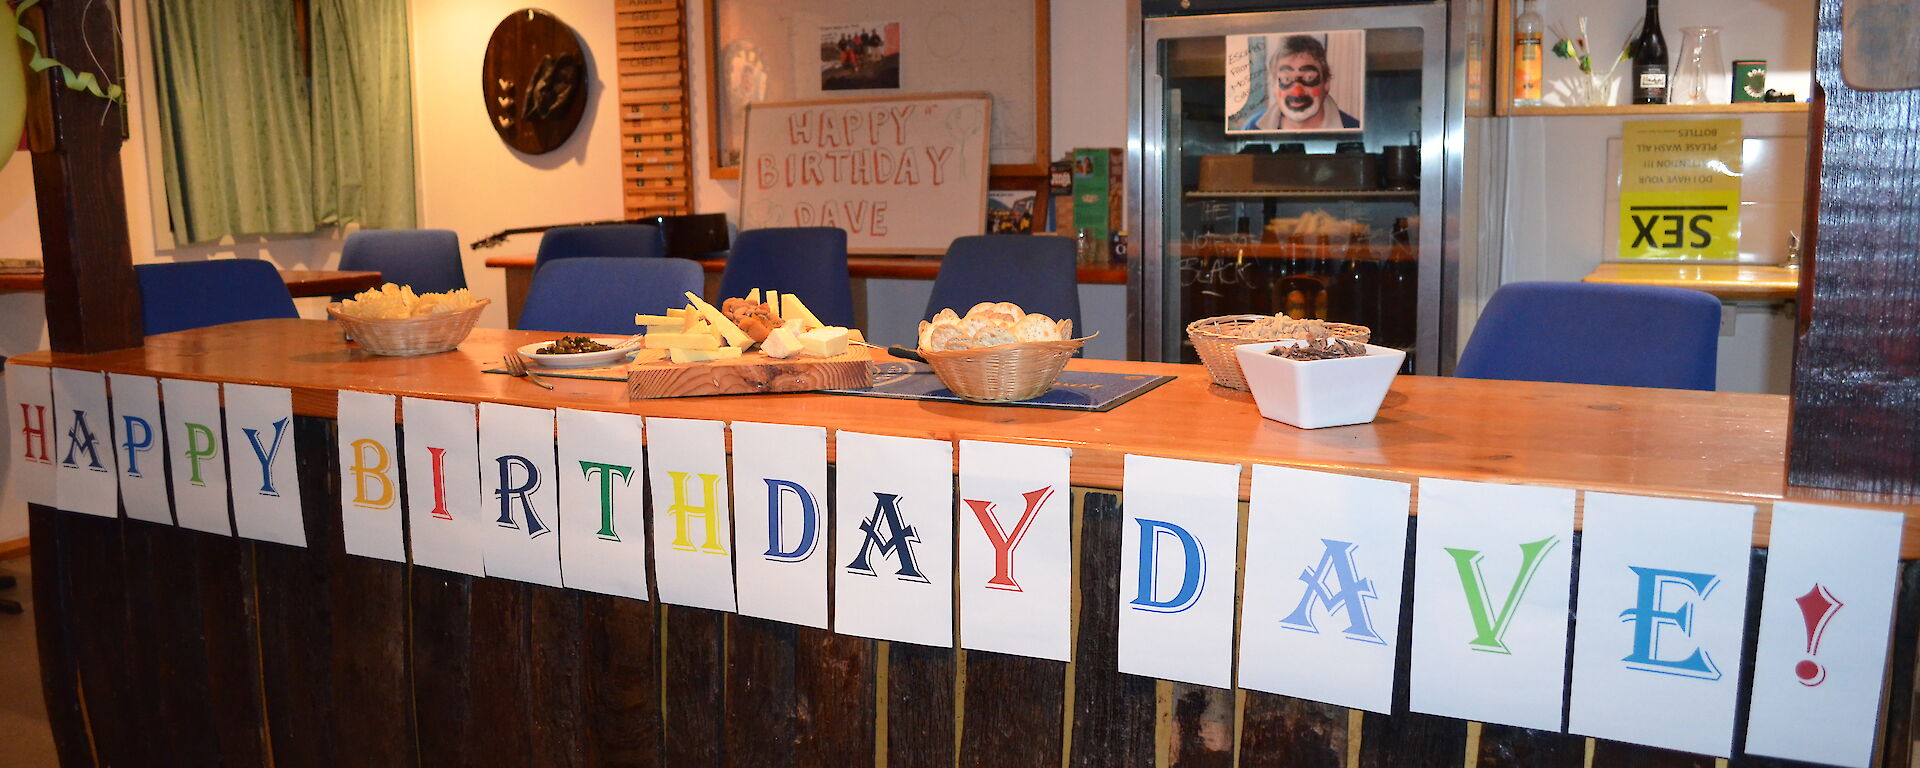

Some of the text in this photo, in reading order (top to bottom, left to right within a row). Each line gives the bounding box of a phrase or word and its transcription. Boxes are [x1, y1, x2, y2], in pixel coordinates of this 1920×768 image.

[788, 104, 915, 148] HAPPY
[1678, 129, 1717, 137] BOTTLES
[1654, 144, 1682, 152] WASH
[1685, 143, 1718, 151] PLEASE
[757, 146, 953, 190] BIRTHDAY
[1666, 176, 1691, 184] HAVE
[1698, 176, 1713, 184] DO
[794, 200, 888, 237] DAVE
[1631, 214, 1713, 249] SEX
[1180, 257, 1257, 289] BLACK
[19, 402, 1845, 688] HAPPY BIRTHDAY DAVE!
